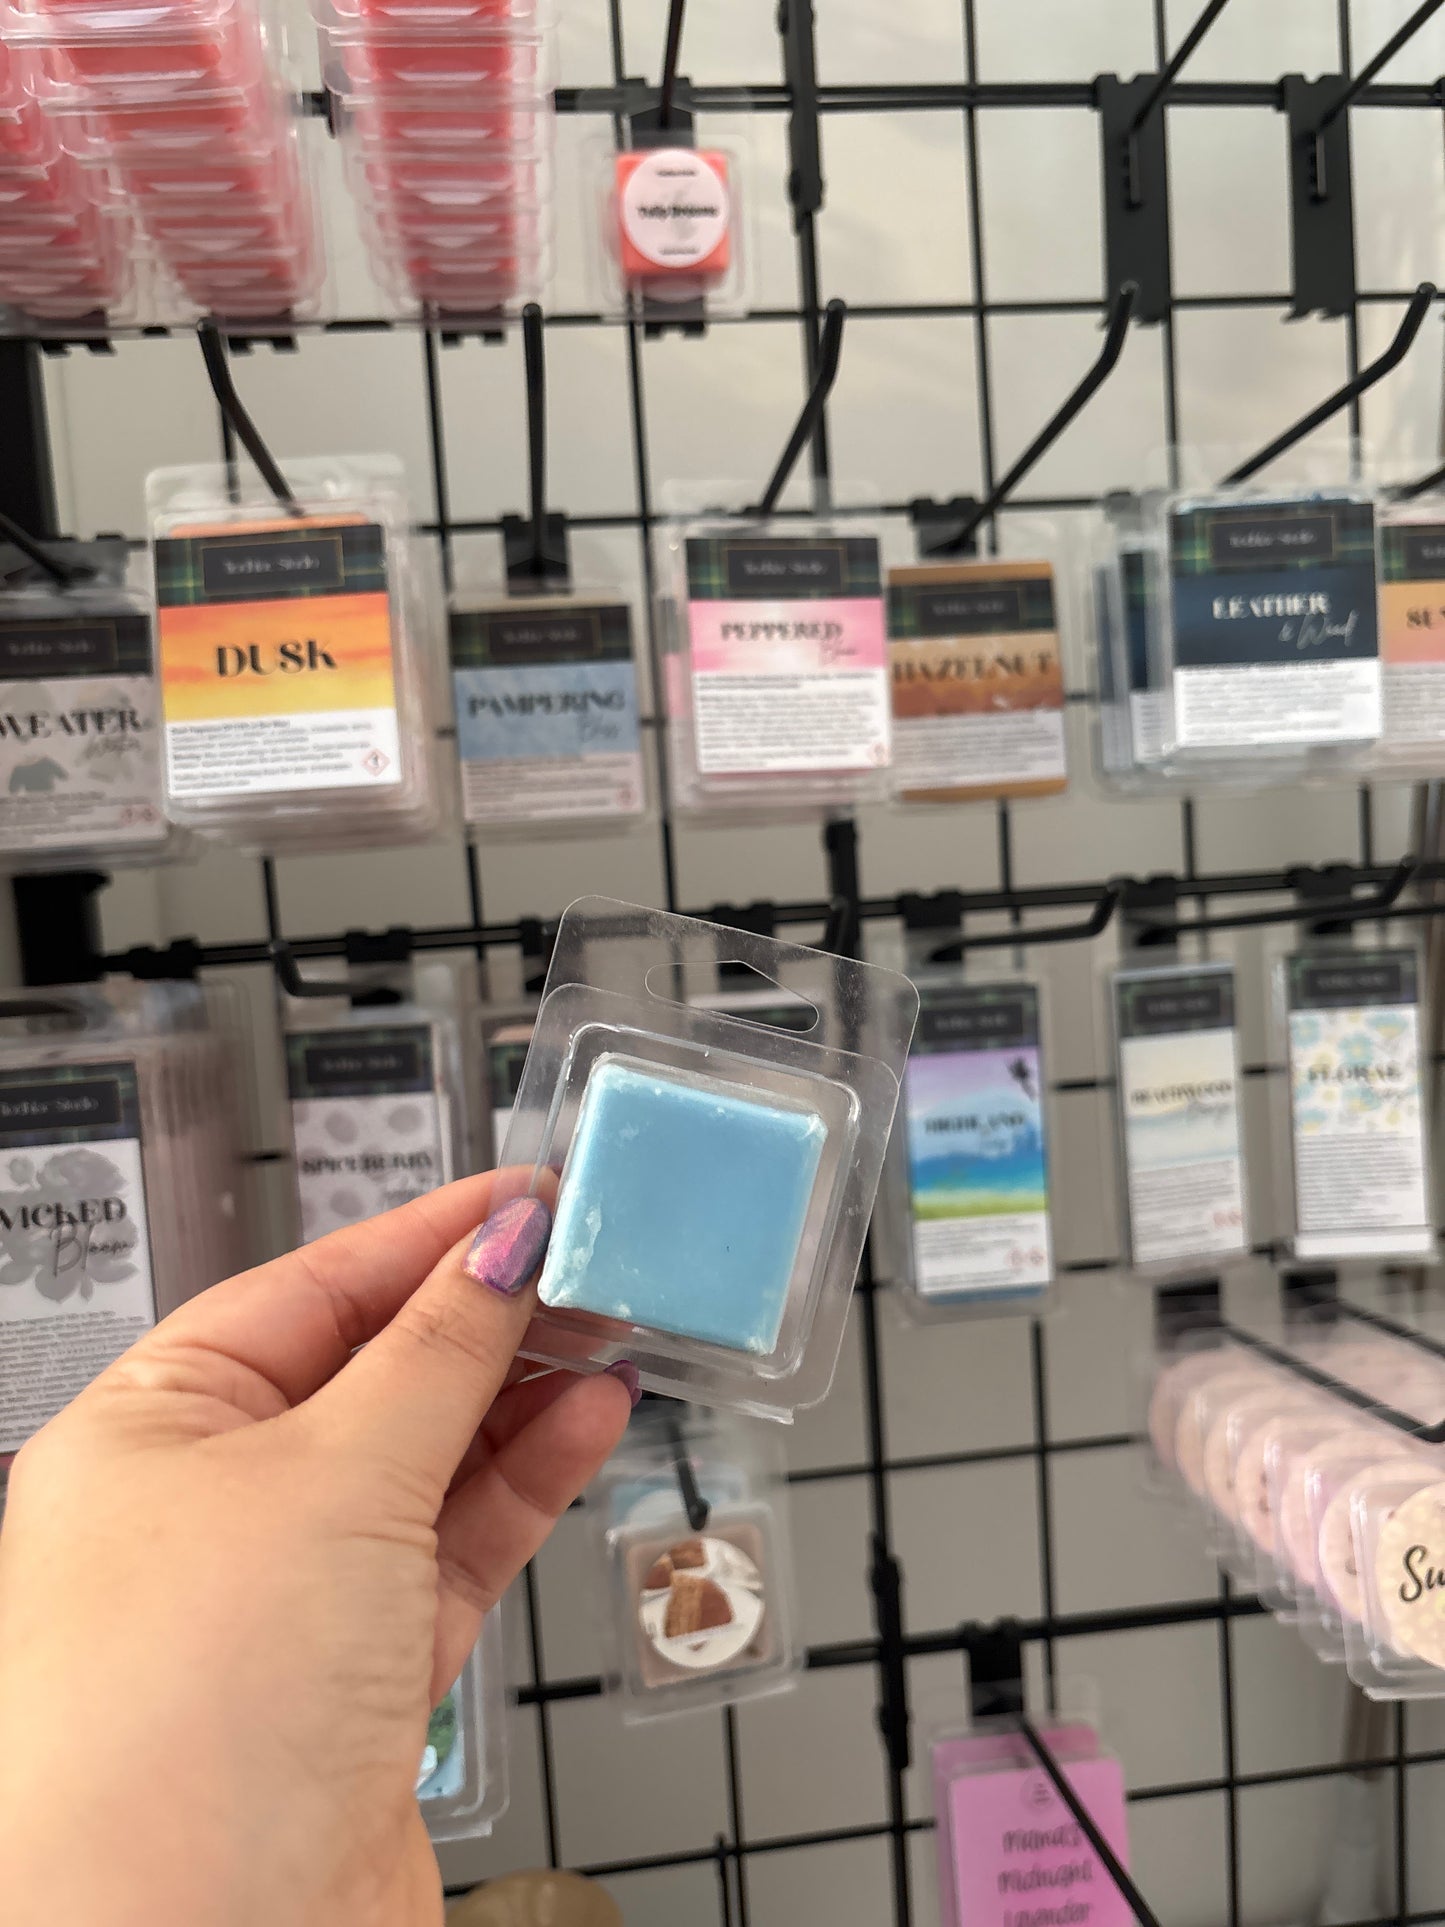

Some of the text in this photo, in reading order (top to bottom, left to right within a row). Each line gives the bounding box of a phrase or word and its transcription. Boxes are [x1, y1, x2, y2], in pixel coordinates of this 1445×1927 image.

[1211, 591, 1330, 621] LEATHER
[215, 639, 338, 677] DUSK
[468, 689, 626, 718] PAMPERING
